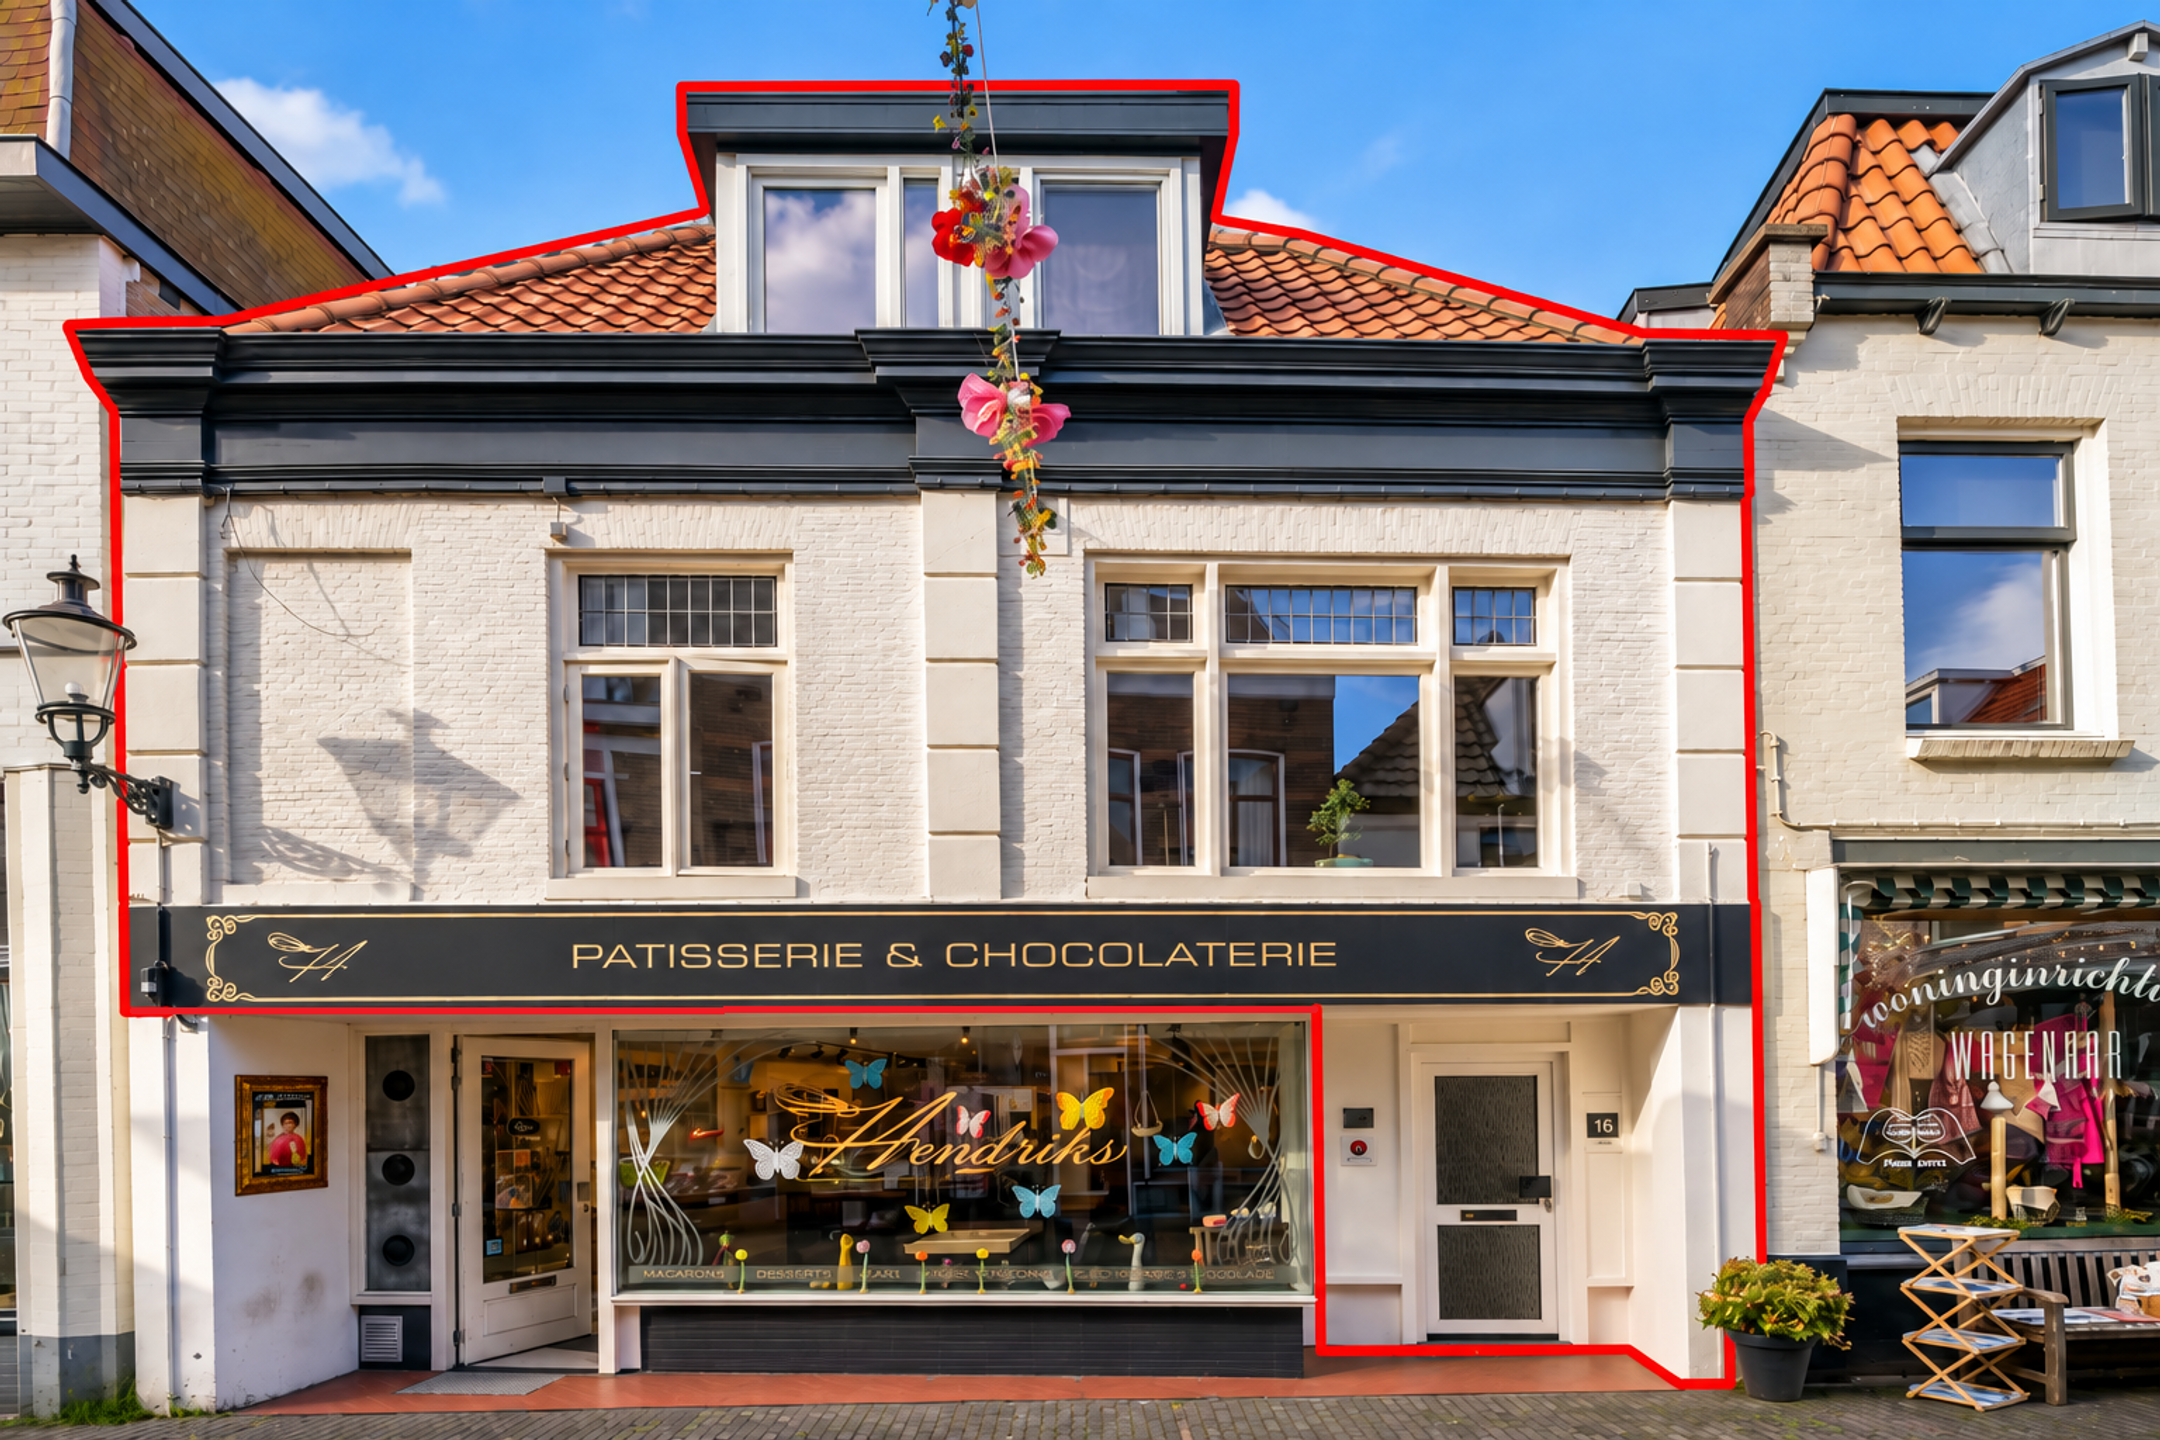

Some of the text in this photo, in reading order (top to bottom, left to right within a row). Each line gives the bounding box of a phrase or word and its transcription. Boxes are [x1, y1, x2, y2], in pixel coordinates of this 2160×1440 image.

[572, 942, 1338, 969] PATISSERIE & CHOCOLATERIE
[1951, 1030, 2123, 1082] WAGENAAR
[788, 1091, 1128, 1178] Hendriks
[1594, 1118, 1613, 1133] 16
[643, 1269, 725, 1279] MACARONS
[756, 1269, 832, 1279] DESSERTS
